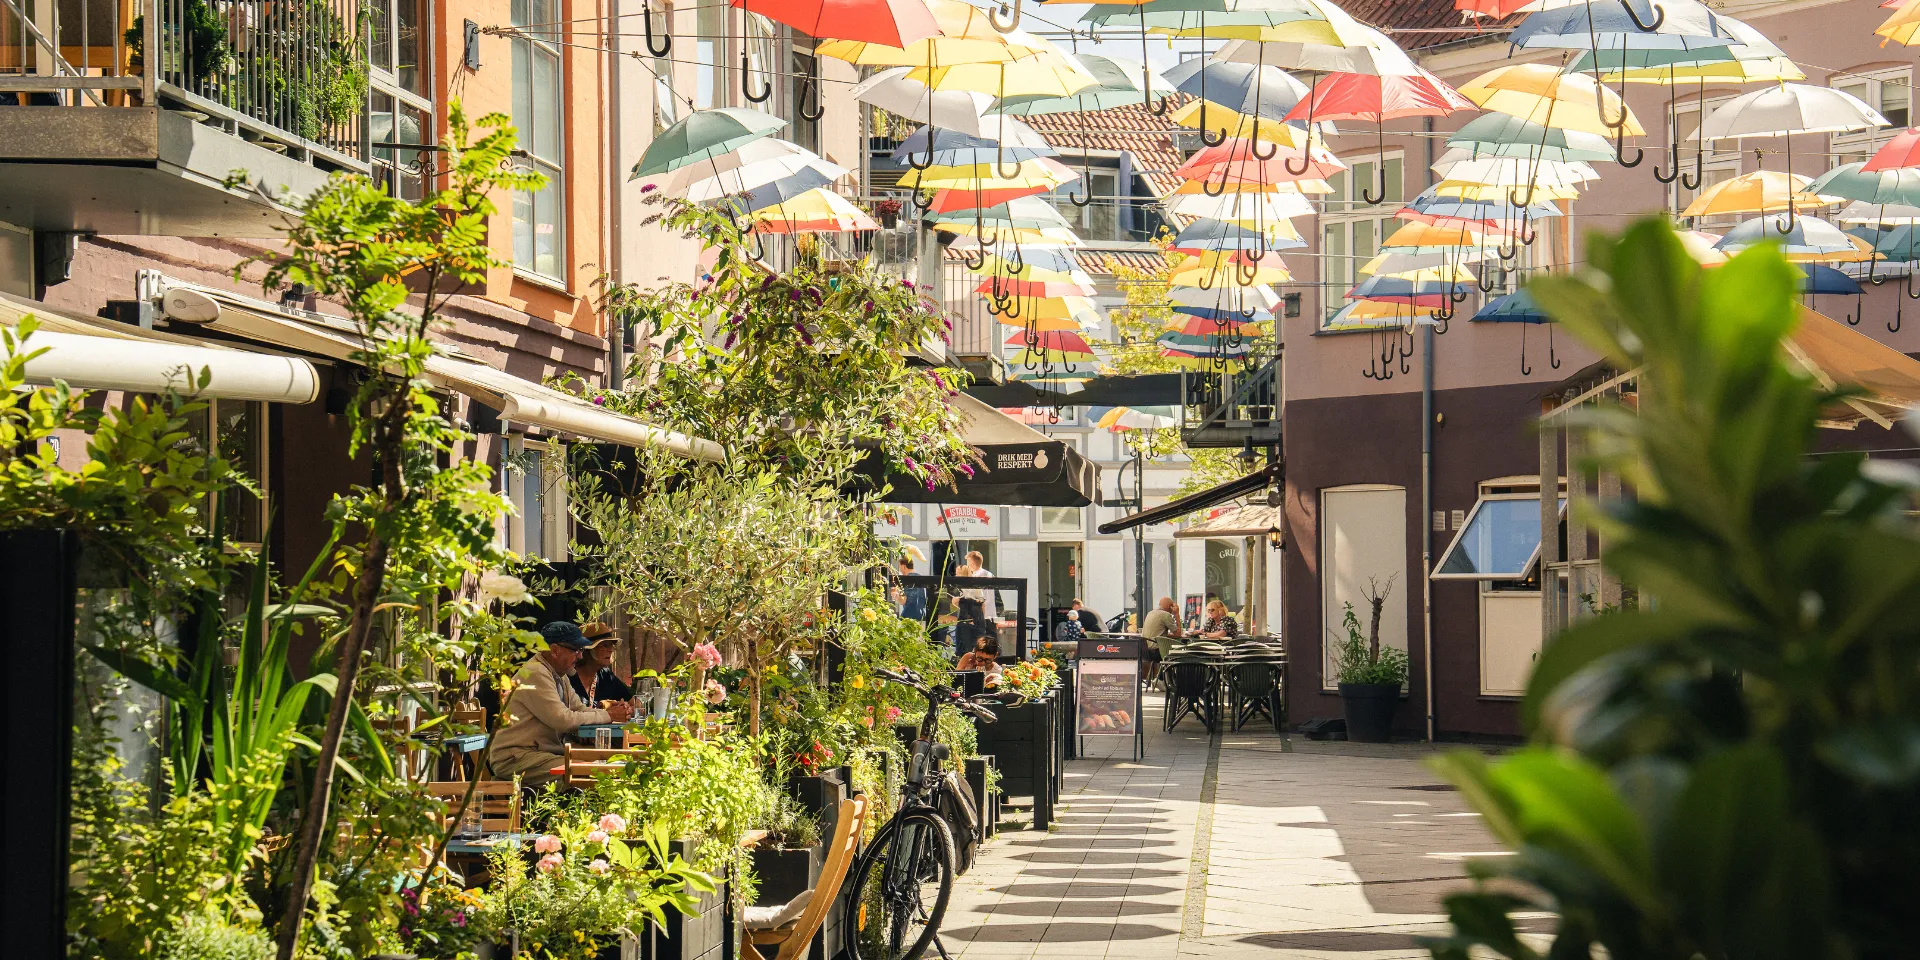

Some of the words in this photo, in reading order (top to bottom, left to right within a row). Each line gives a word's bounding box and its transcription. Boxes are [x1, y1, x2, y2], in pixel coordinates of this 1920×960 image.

[998, 453, 1016, 461] DRIK
[1016, 453, 1033, 461] MED
[998, 460, 1033, 469] RESPEKT
[950, 507, 978, 517] ISTANBUL
